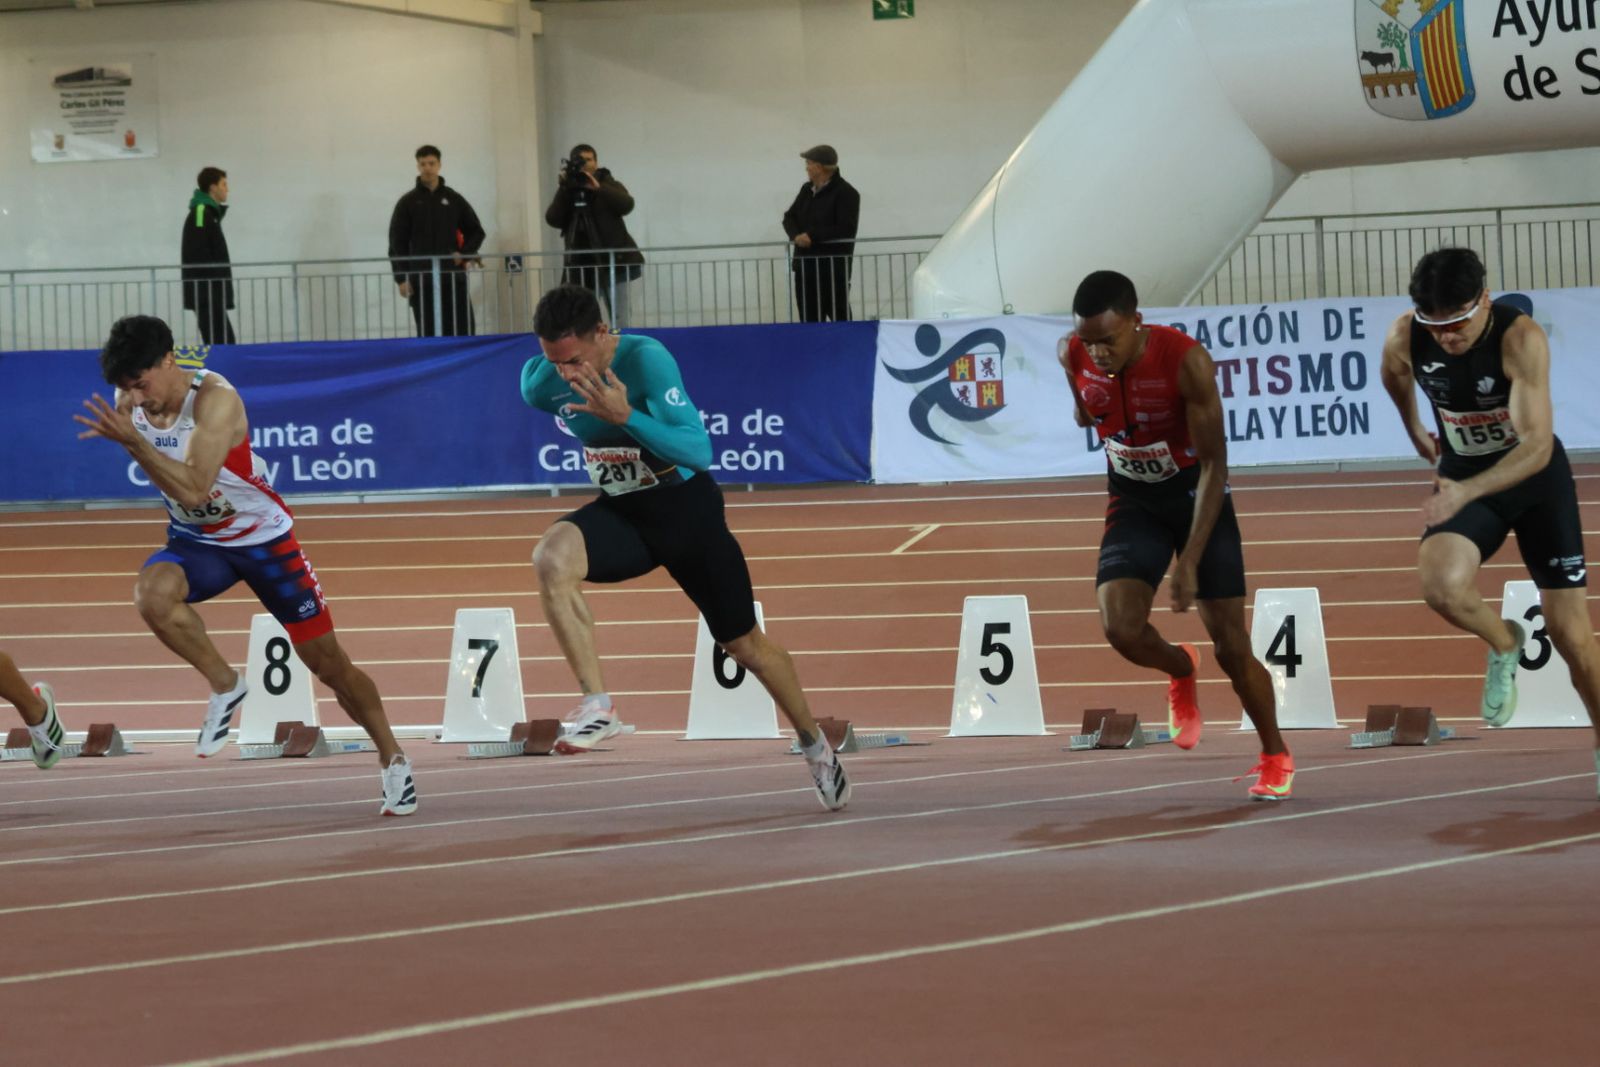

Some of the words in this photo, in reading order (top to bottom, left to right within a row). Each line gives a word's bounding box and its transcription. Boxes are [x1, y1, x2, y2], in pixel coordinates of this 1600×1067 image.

[1503, 55, 1561, 101] de
[1323, 307, 1366, 341] DE
[1213, 351, 1368, 398] TISMO
[249, 422, 319, 448] unta
[331, 417, 375, 445] de
[700, 410, 729, 435] ta
[742, 408, 784, 436] de
[1268, 406, 1287, 438] Y
[1295, 396, 1371, 437] LEÓN
[1455, 422, 1506, 446] 155
[155, 435, 179, 448] aula
[538, 444, 588, 472] Ca
[292, 452, 376, 481] León
[596, 461, 637, 486] 287
[1117, 457, 1164, 475] 280
[979, 621, 1014, 686] 5
[1264, 614, 1303, 678] 4
[1517, 604, 1553, 671] 3
[263, 636, 292, 696] 8
[468, 638, 500, 698] 7
[712, 642, 747, 690] 6
